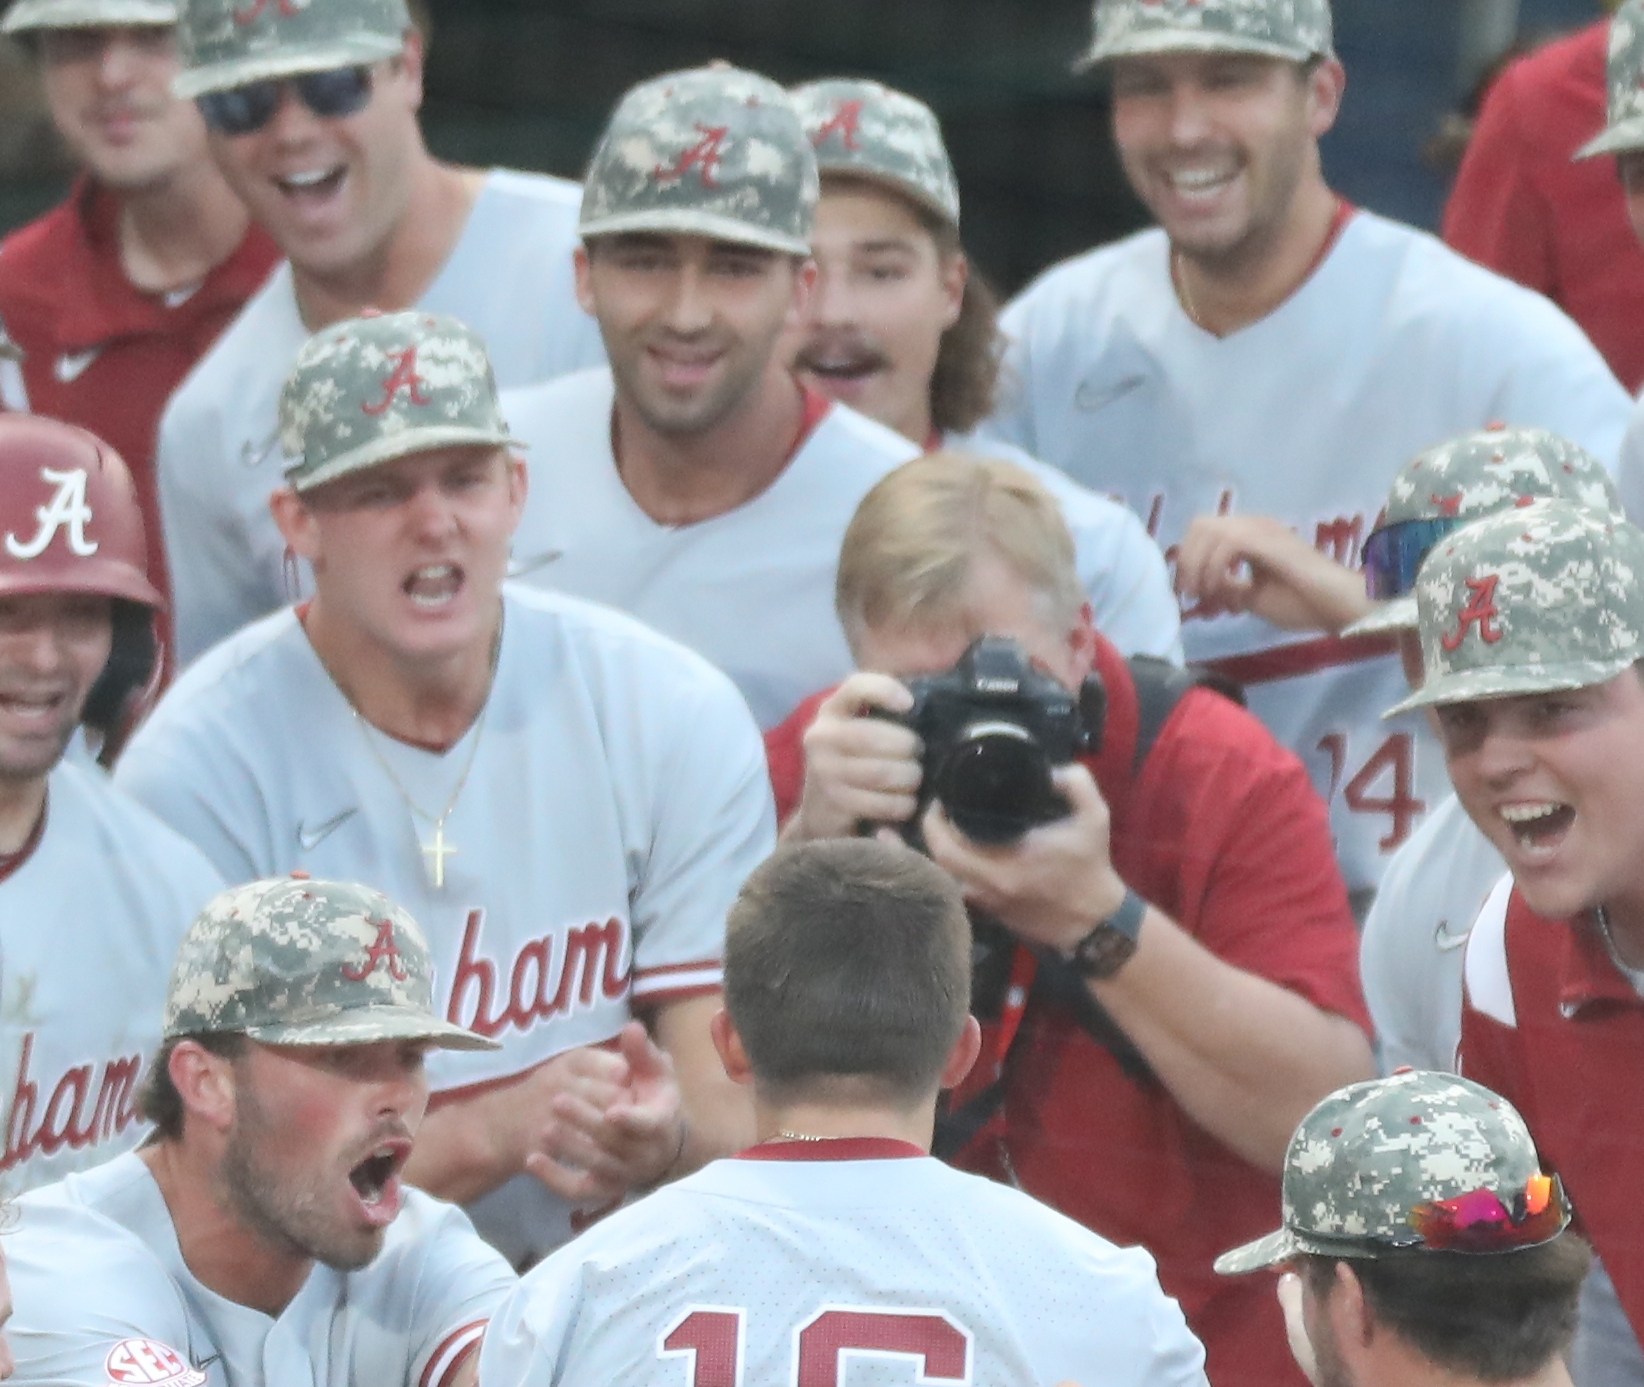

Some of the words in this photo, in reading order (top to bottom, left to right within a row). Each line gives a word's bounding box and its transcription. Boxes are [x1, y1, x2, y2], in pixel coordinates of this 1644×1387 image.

[654, 123, 728, 189] A
[812, 98, 865, 151] A
[362, 345, 431, 415] A
[5, 467, 99, 559] A
[1443, 576, 1503, 651] A
[1314, 732, 1426, 855] 14
[343, 916, 407, 983] A
[109, 1340, 184, 1382] SEC
